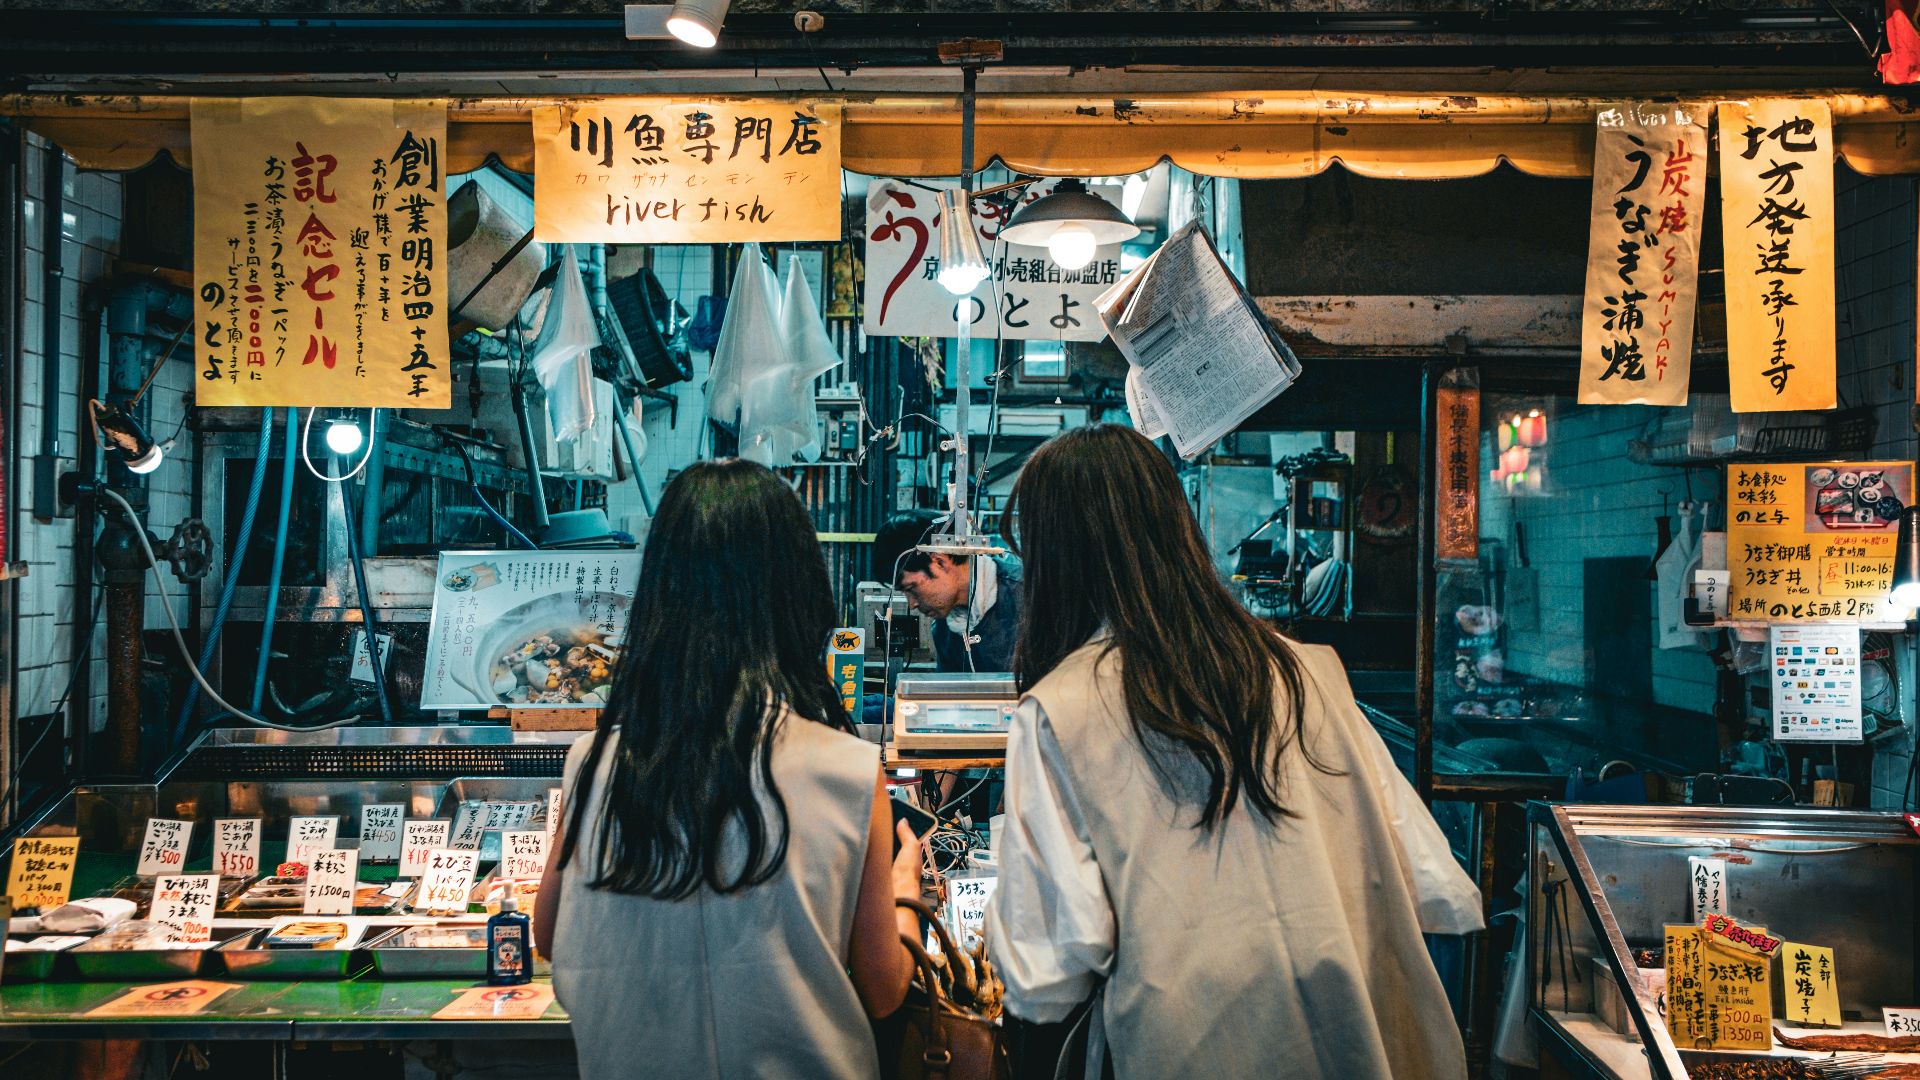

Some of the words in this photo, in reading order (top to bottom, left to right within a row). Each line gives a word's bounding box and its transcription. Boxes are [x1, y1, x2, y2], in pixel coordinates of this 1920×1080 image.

[570, 110, 822, 168] 川魚専門店
[1656, 139, 1693, 237] 炭焼
[606, 194, 687, 225] river
[698, 195, 774, 224] fish
[371, 158, 392, 322] おかげ様で百十年を
[291, 141, 340, 369] 記念セール
[390, 130, 438, 397] 創業明治四十五年
[1598, 134, 1659, 382] うなぎ蒲焼
[1740, 116, 1818, 396] 地方発送承ります
[349, 227, 370, 378] 迎える事ができました
[953, 292, 1081, 329] のとよ
[1655, 246, 1677, 382] SUMIYAKI
[200, 282, 226, 381] のとよ
[1738, 470, 1786, 488] お食事処
[1738, 489, 1777, 504] 味彩
[1736, 509, 1789, 524] のと与
[1744, 543, 1811, 563] うなぎ御膳
[1825, 546, 1866, 556] 営業時間
[1745, 568, 1802, 586] うなぎ丼
[1738, 598, 1766, 614] 場所
[1770, 601, 1841, 618] のとよ西店
[366, 806, 398, 818] びわ湖産
[222, 821, 254, 831] びわ湖
[222, 832, 252, 843] こあゆ
[510, 834, 540, 846] すっぽん
[155, 848, 180, 864] ¥500
[221, 852, 253, 870] ¥550
[433, 854, 472, 872] えび豆
[314, 860, 346, 874] 本もろこ
[517, 858, 542, 874] 950円
[164, 879, 208, 890] びわ湖
[957, 882, 986, 896] うなぎの
[428, 886, 464, 902] ¥450
[1712, 917, 1728, 932] 今
[1708, 962, 1764, 984] うなぎのキモ
[1819, 954, 1831, 991] 全部
[1794, 949, 1815, 1015] 炭焼です
[1724, 1006, 1762, 1024] 500円
